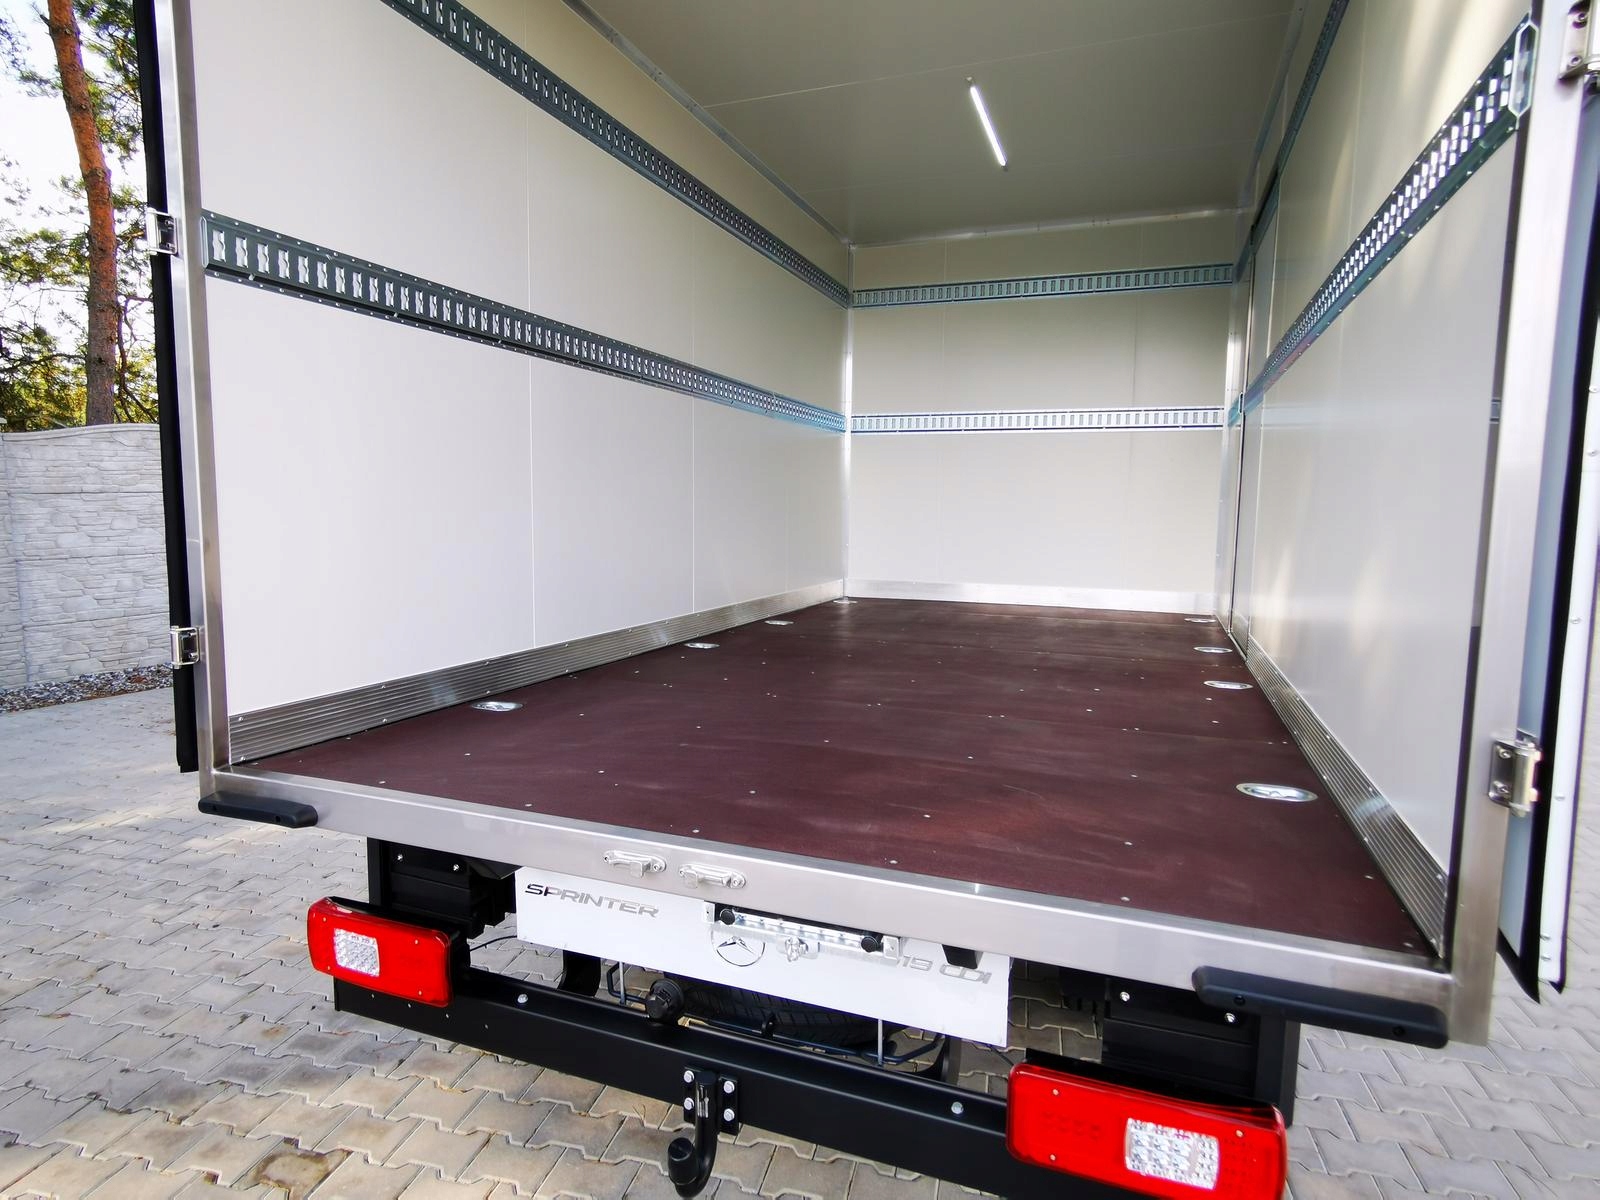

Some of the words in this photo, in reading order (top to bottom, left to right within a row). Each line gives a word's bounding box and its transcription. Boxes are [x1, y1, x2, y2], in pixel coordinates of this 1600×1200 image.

[525, 883, 659, 918] SPRINTER
[896, 955, 933, 972] 19
[940, 963, 992, 984] CDI
